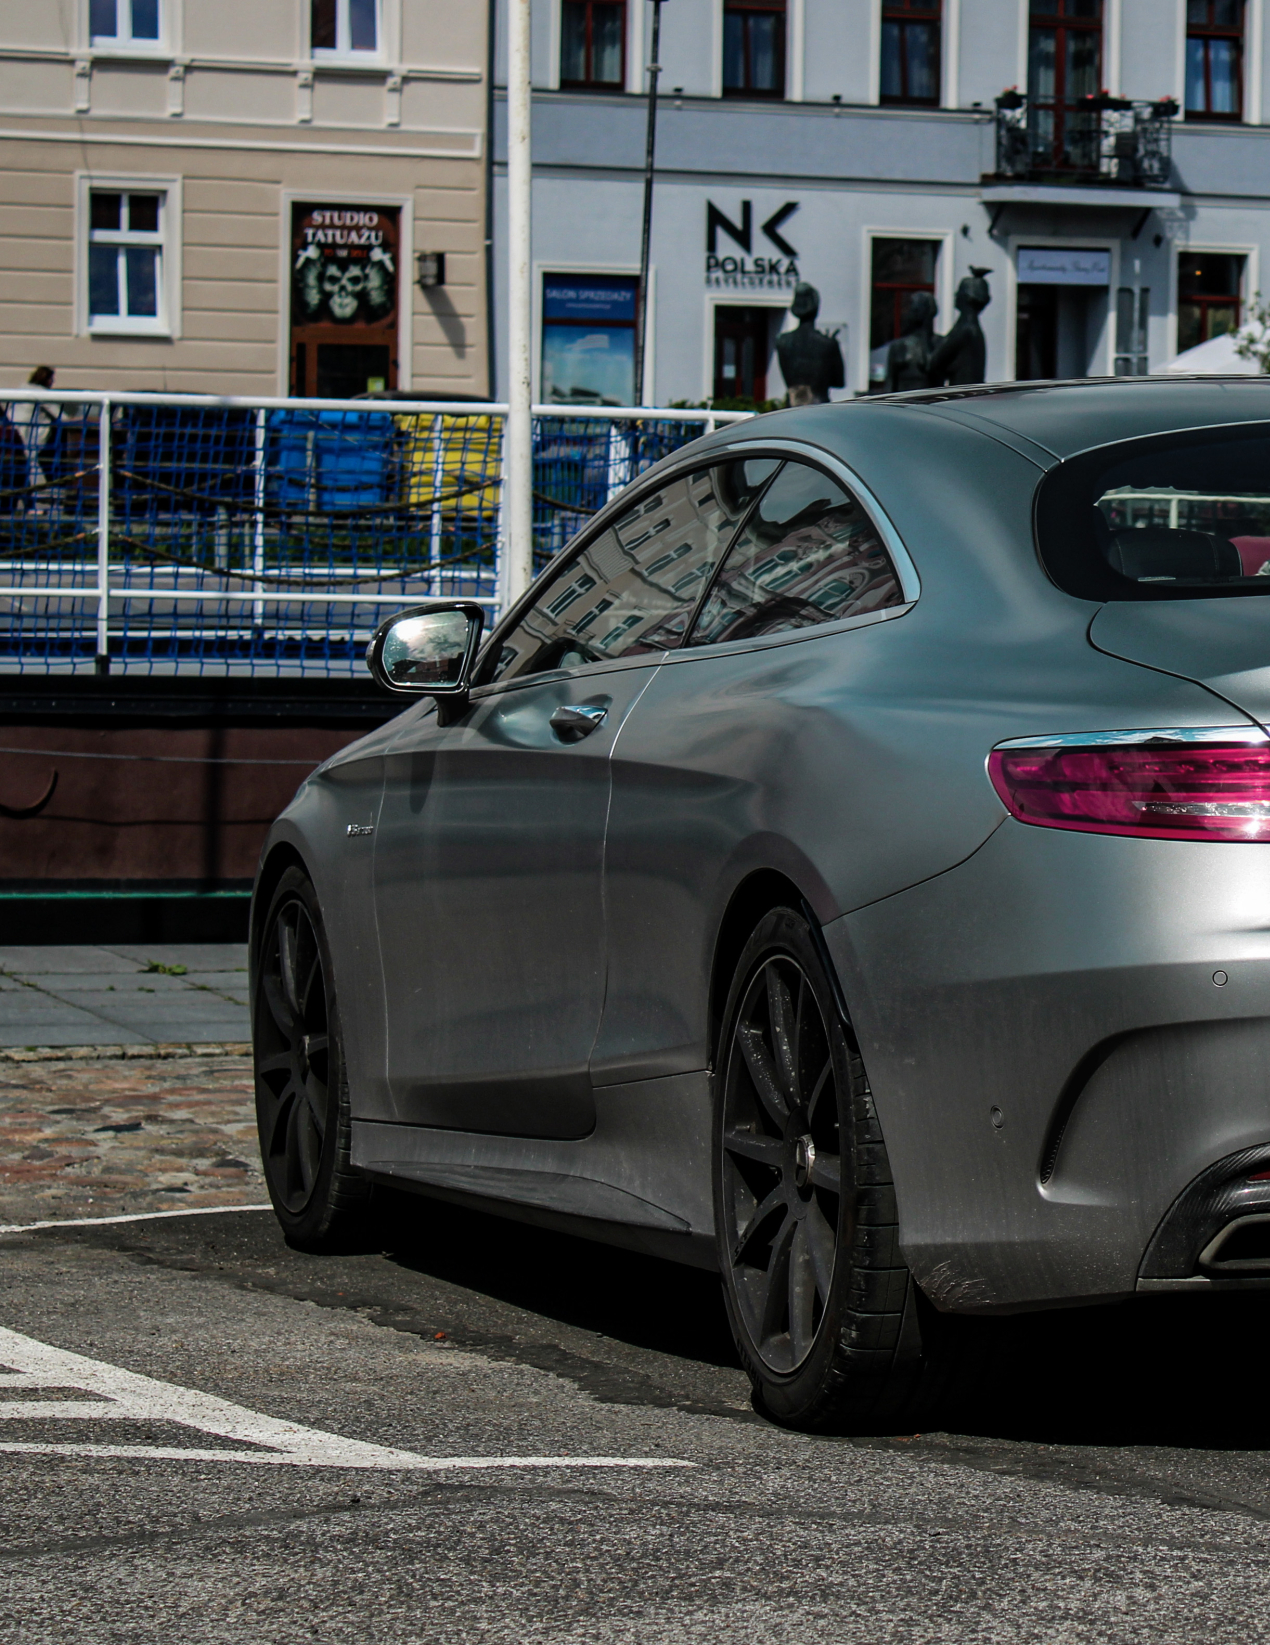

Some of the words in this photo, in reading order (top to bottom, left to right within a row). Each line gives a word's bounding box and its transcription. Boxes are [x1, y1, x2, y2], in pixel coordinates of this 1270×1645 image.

[311, 210, 379, 227] STUDIO
[304, 227, 383, 246] TATUAŻU
[706, 255, 799, 276] POLSKA
